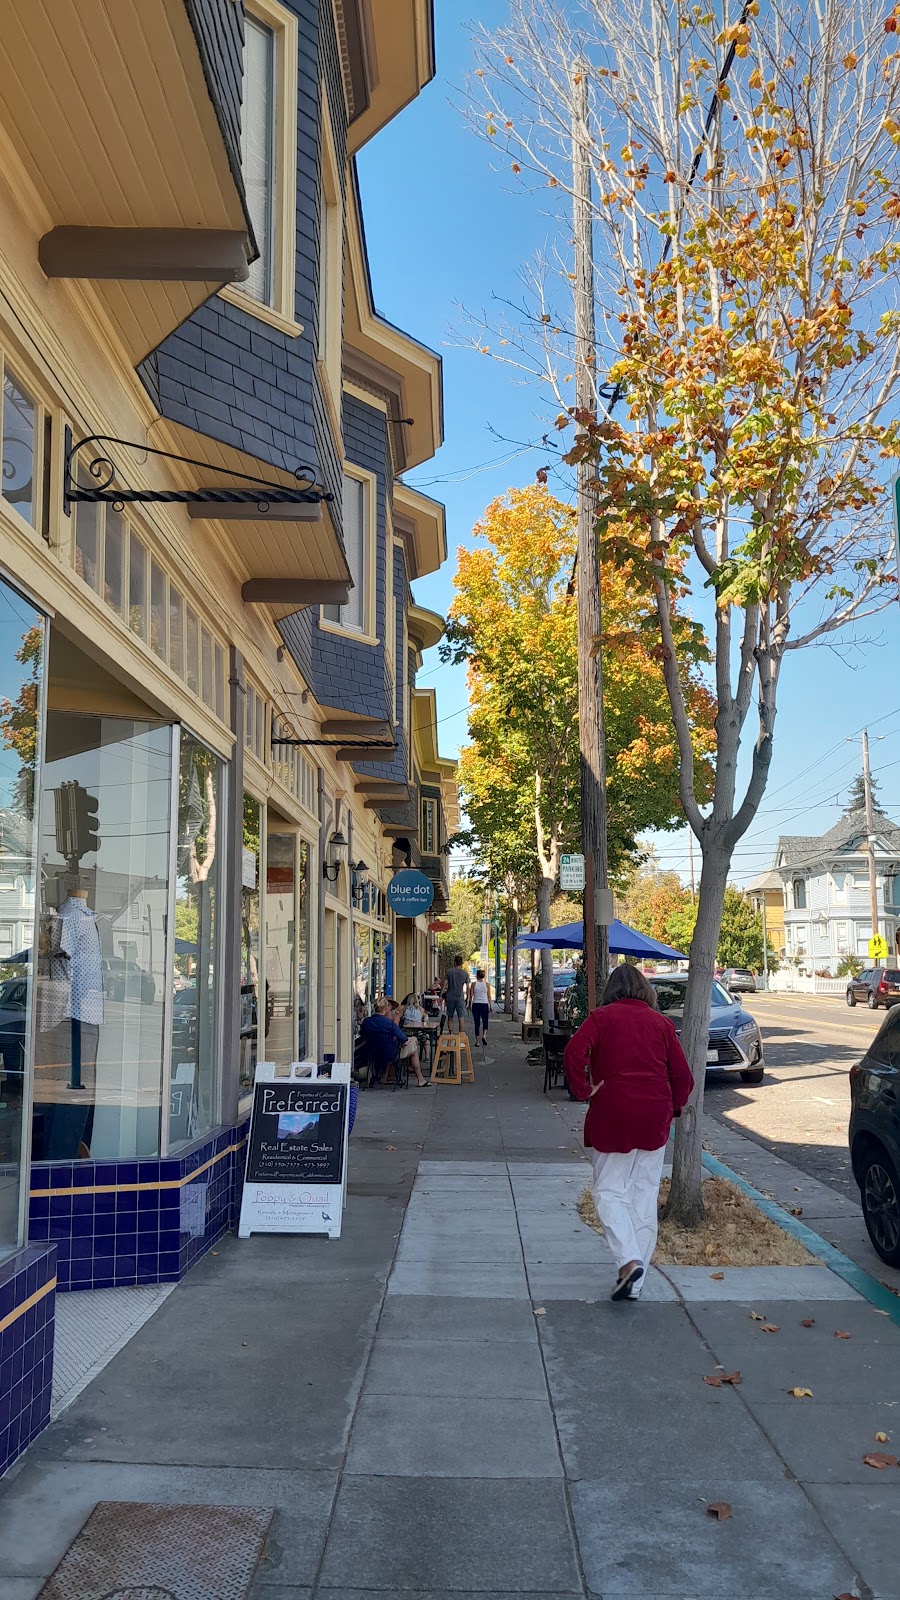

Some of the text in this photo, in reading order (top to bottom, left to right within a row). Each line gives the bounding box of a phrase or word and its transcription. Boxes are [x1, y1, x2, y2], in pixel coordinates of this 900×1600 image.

[390, 884, 430, 894] blue dot
[262, 1089, 341, 1114] Preferred
[260, 1142, 333, 1152] Real Estate Sales
[256, 1190, 329, 1205] Poppy & Quail
